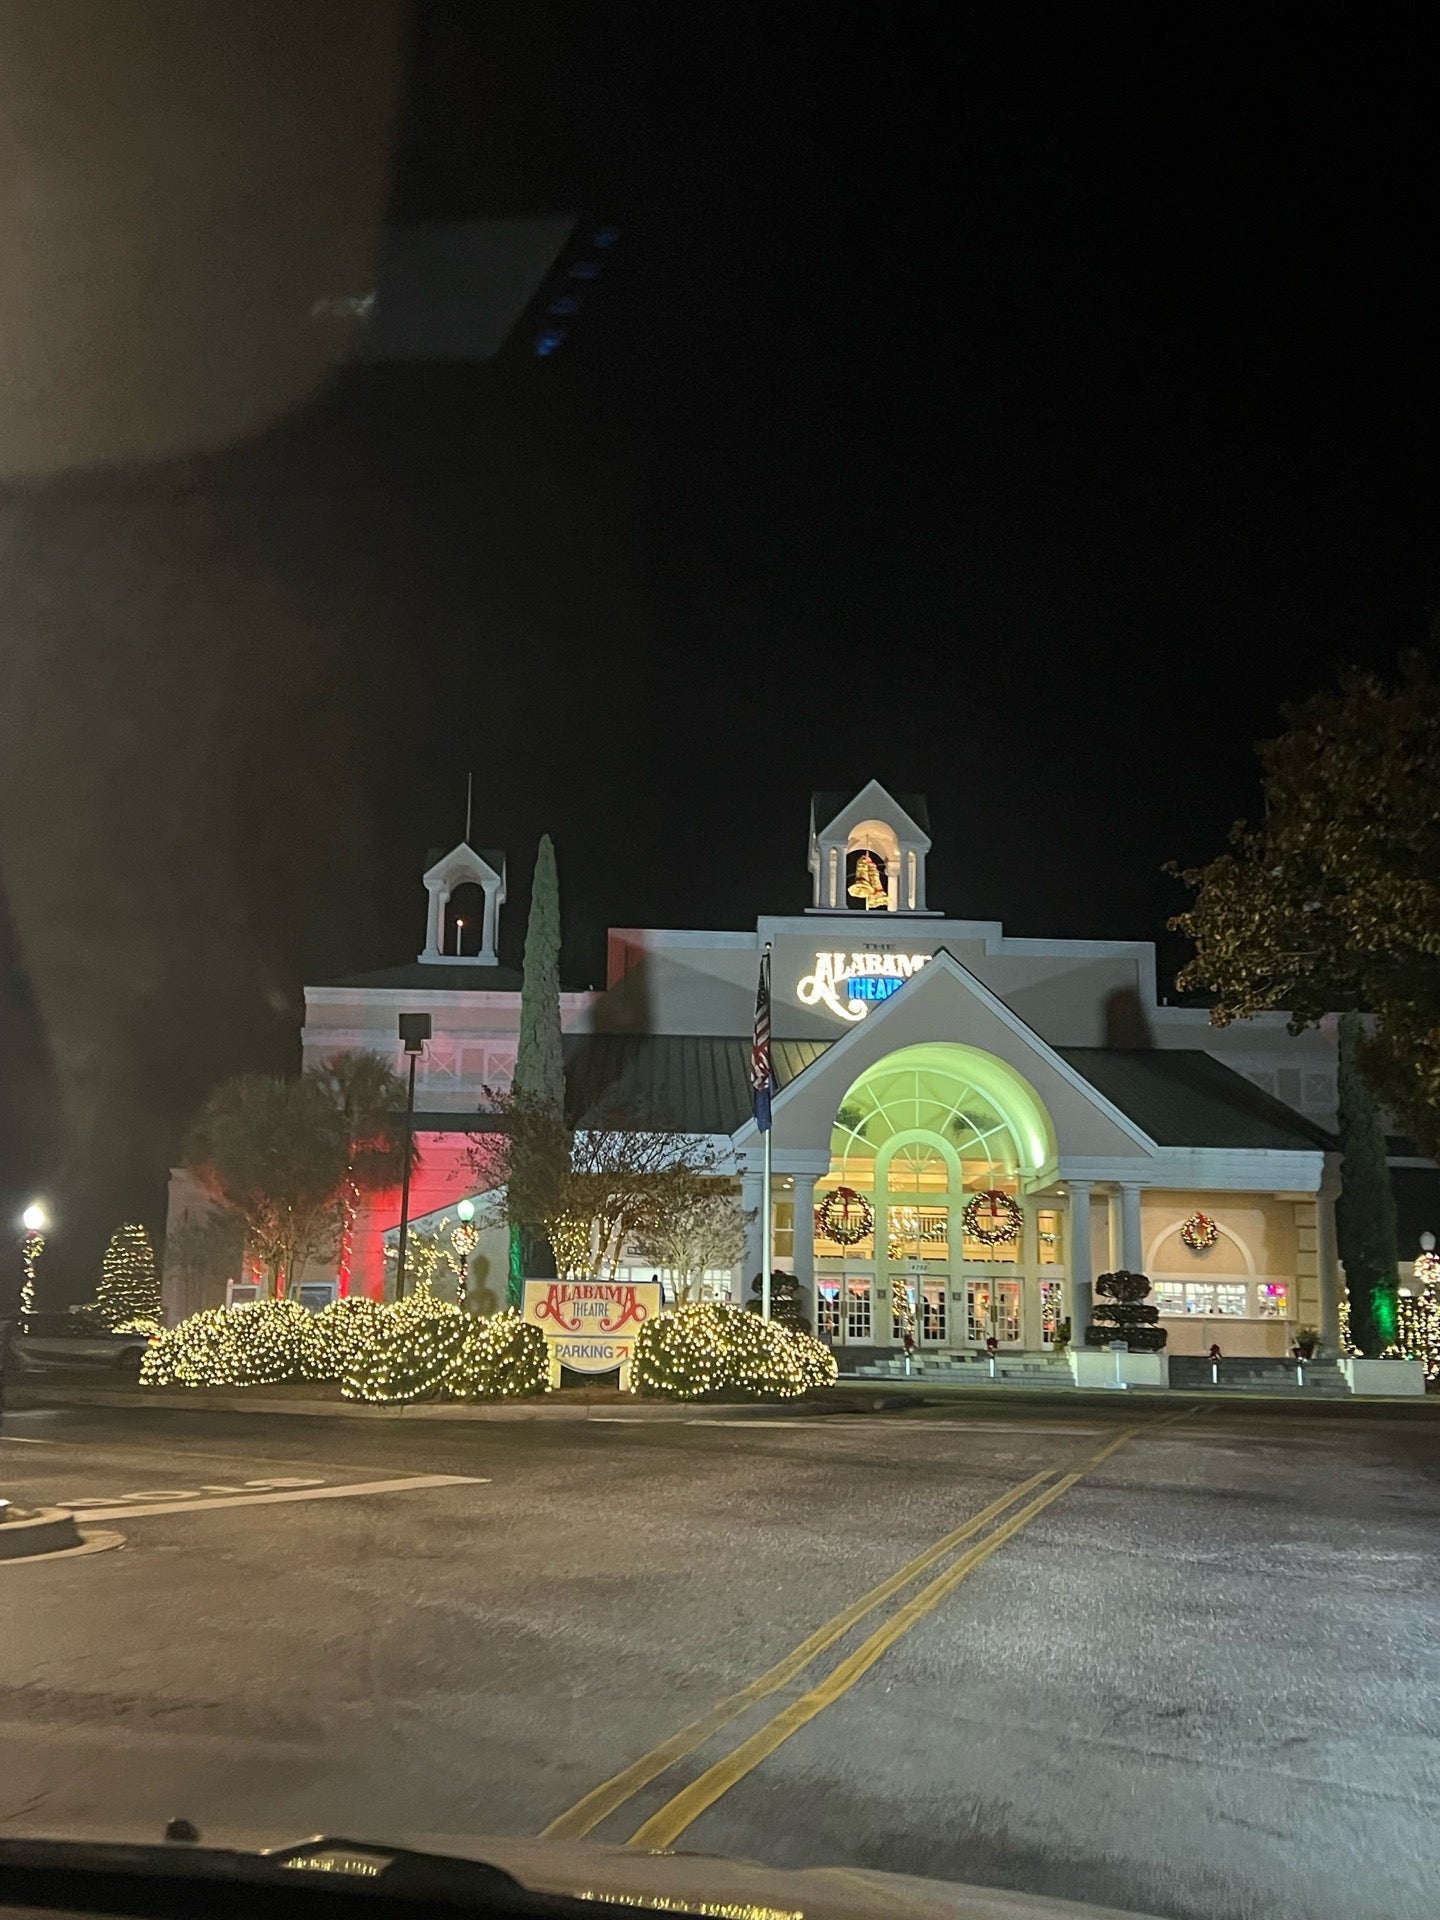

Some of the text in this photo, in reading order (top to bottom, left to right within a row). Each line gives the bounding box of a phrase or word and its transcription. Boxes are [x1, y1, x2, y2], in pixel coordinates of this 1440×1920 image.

[863, 943, 896, 951] THE
[796, 952, 933, 1021] ALABAM
[533, 1284, 647, 1332] ALABAMA
[572, 1302, 609, 1317] THEATRE
[555, 1344, 613, 1359] PARKING
[56, 1477, 325, 1507] STOP
